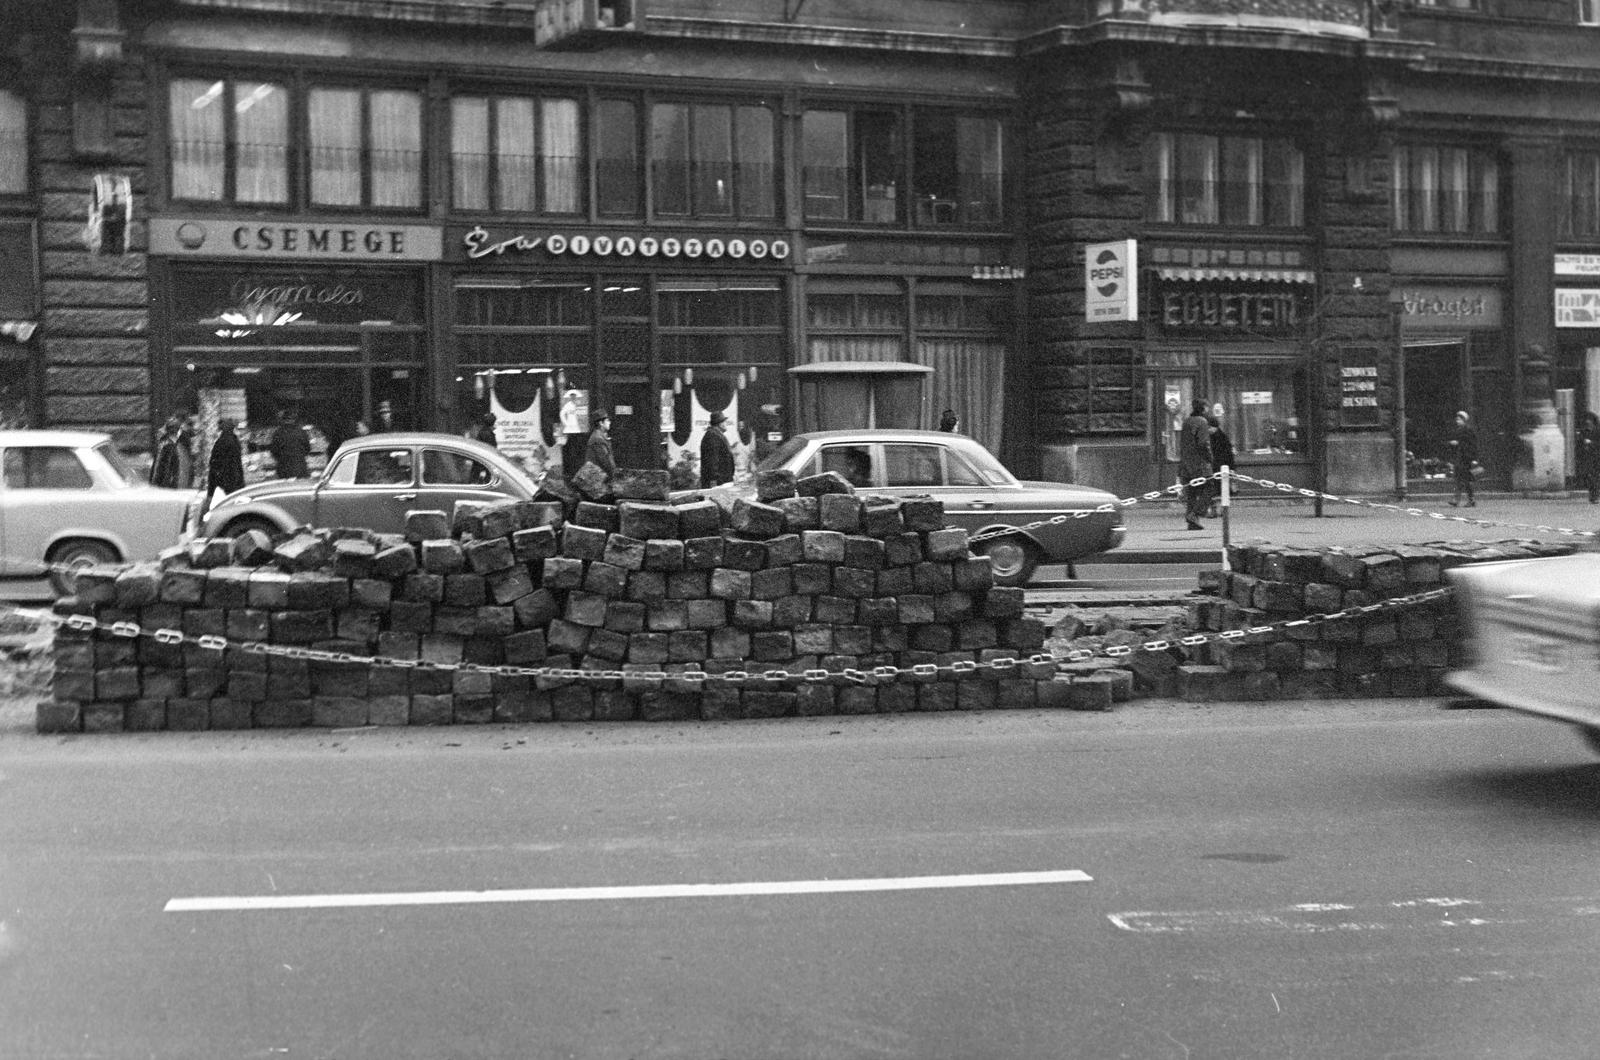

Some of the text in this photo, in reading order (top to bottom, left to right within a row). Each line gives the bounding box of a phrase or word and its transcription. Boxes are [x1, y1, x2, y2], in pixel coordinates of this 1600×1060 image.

[233, 226, 405, 254] CSEMEGE
[547, 235, 789, 259] DIVATSZALON
[1090, 266, 1124, 281] PEPSI
[1163, 291, 1297, 326] EGYETEM
